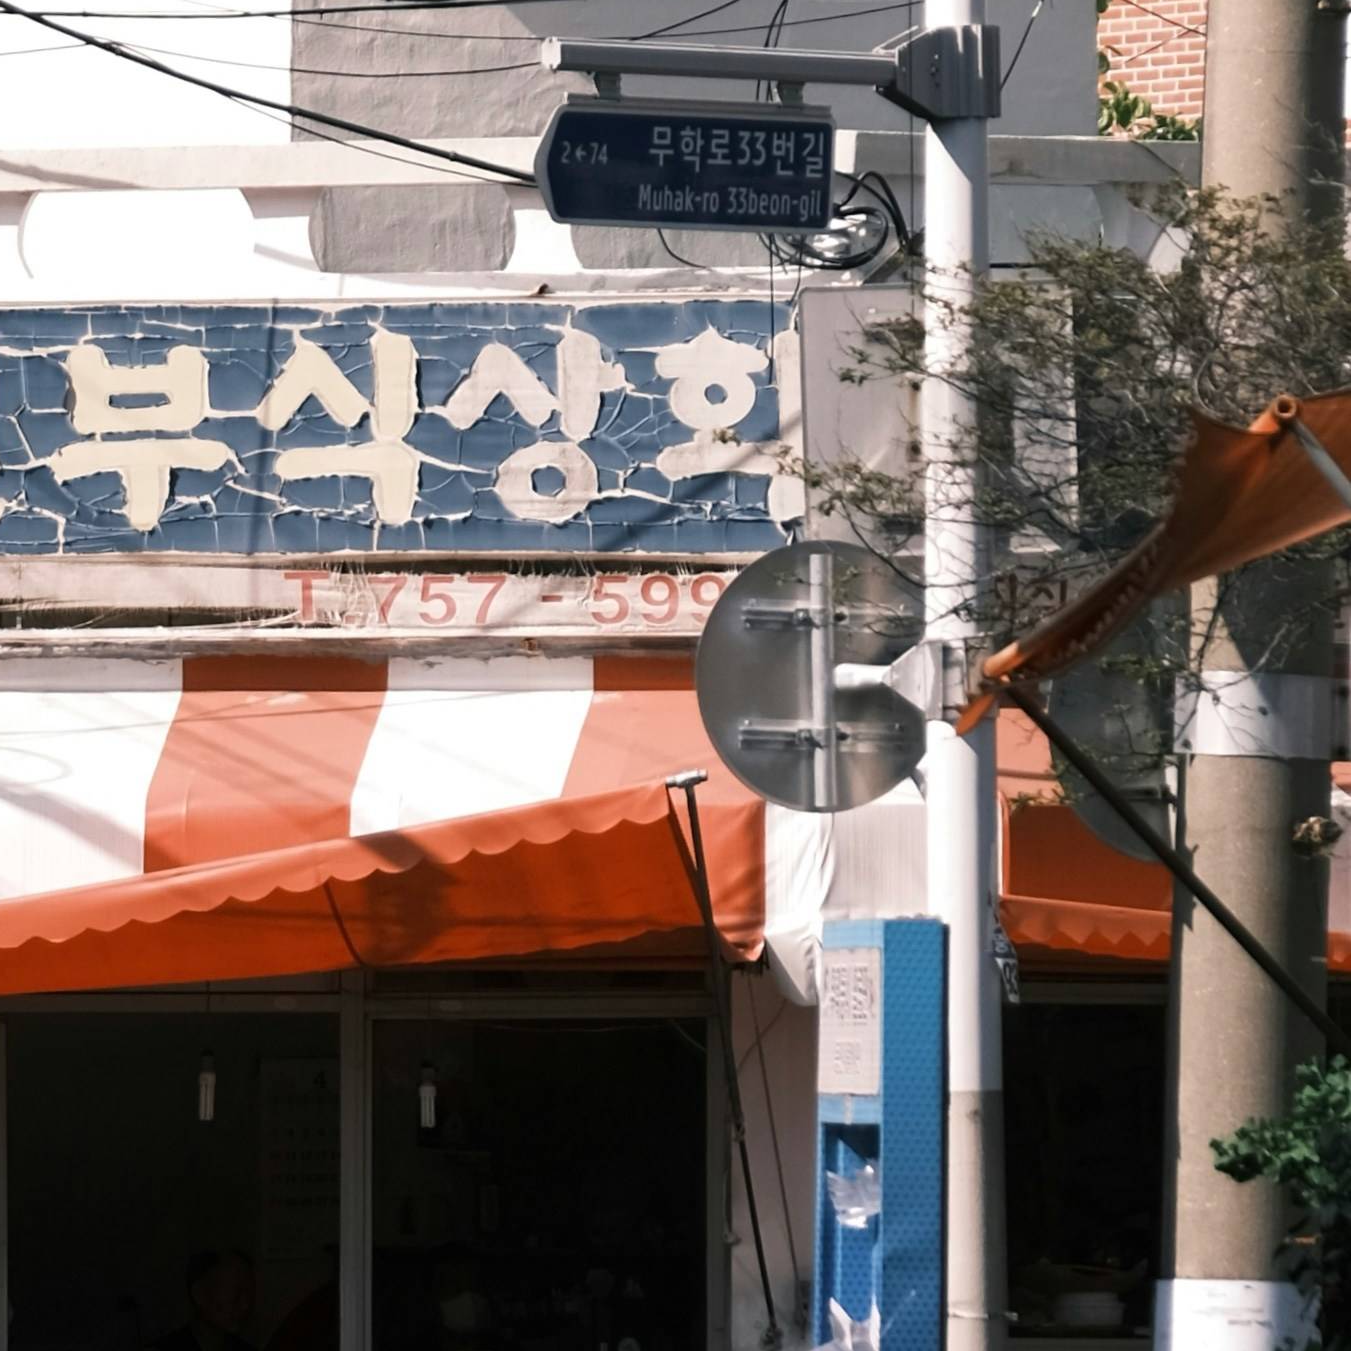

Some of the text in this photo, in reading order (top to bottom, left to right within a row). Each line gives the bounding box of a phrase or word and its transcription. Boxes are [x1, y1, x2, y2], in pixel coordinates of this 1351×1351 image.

[649, 125, 825, 179] 무학로33번길
[638, 183, 822, 223] Muhak-ro 33beon-gil
